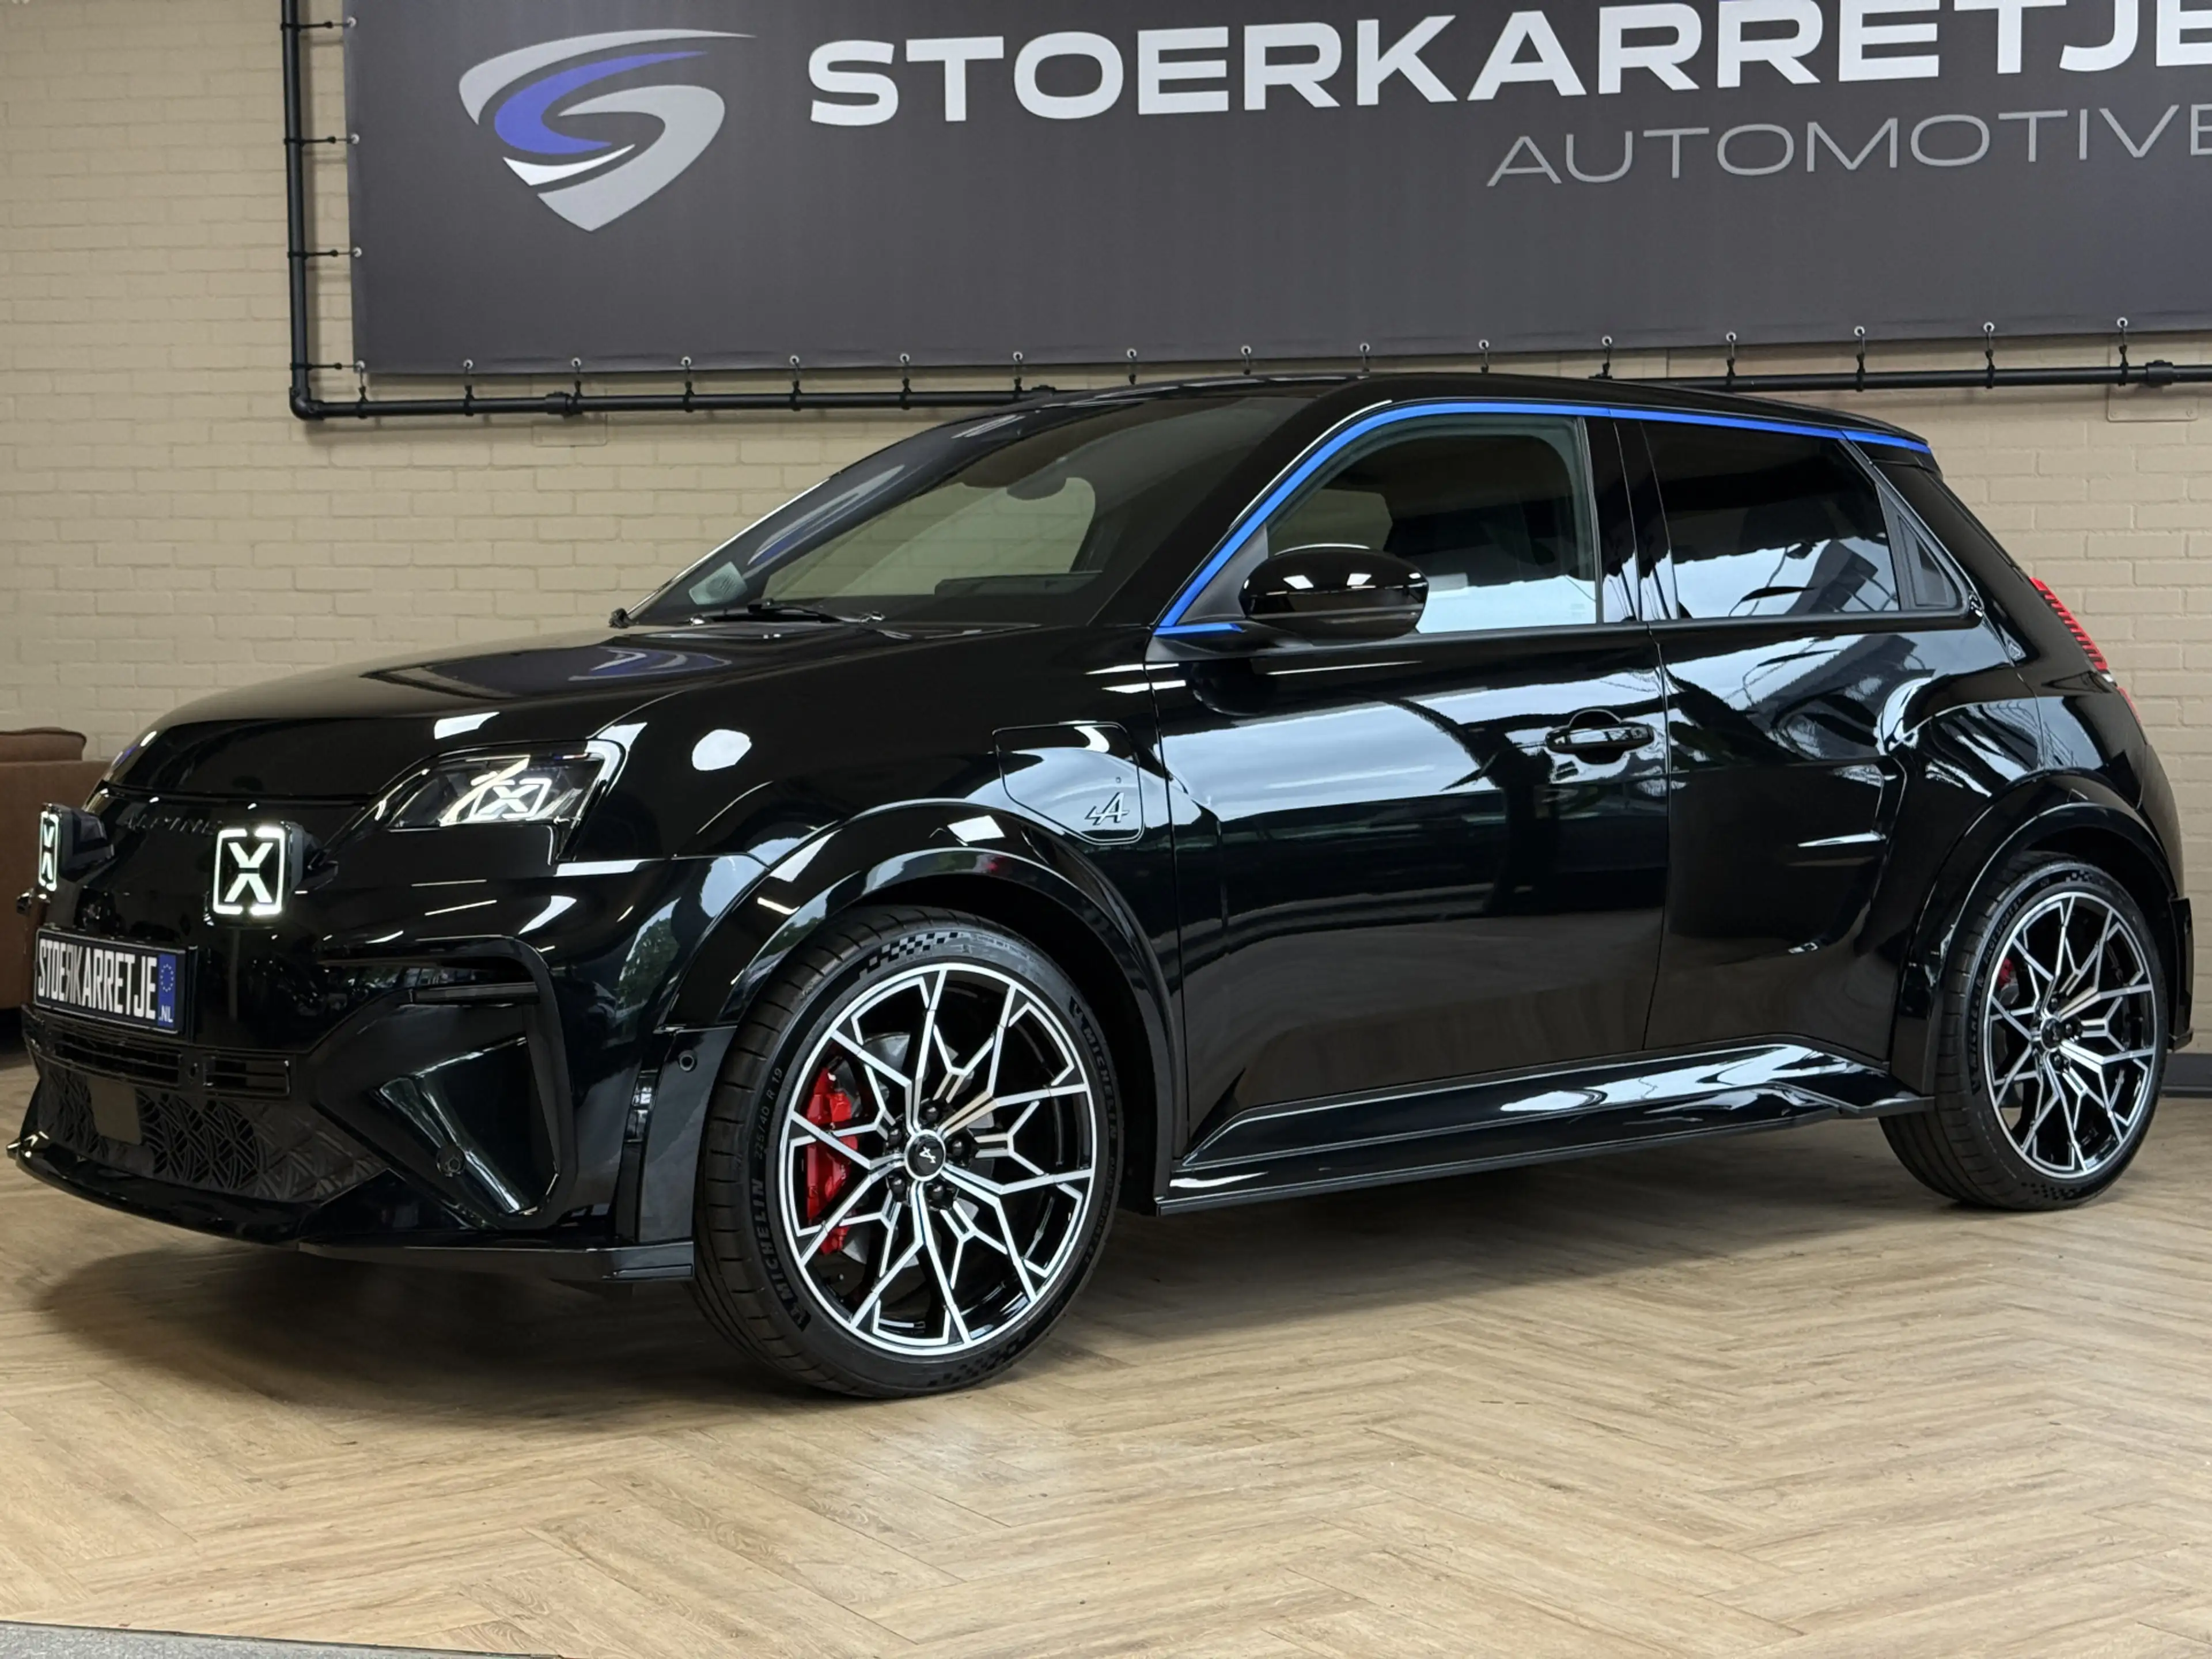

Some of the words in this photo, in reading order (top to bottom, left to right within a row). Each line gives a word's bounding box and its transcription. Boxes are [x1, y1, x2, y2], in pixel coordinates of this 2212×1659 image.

[38, 938, 157, 1020] STOERKARRETJE
[754, 1106, 770, 1160] 225/40
[766, 1089, 775, 1100] R
[772, 1068, 783, 1083] 19
[1084, 1027, 1116, 1139] MICHELIN
[751, 1179, 794, 1302] MICHELIN
